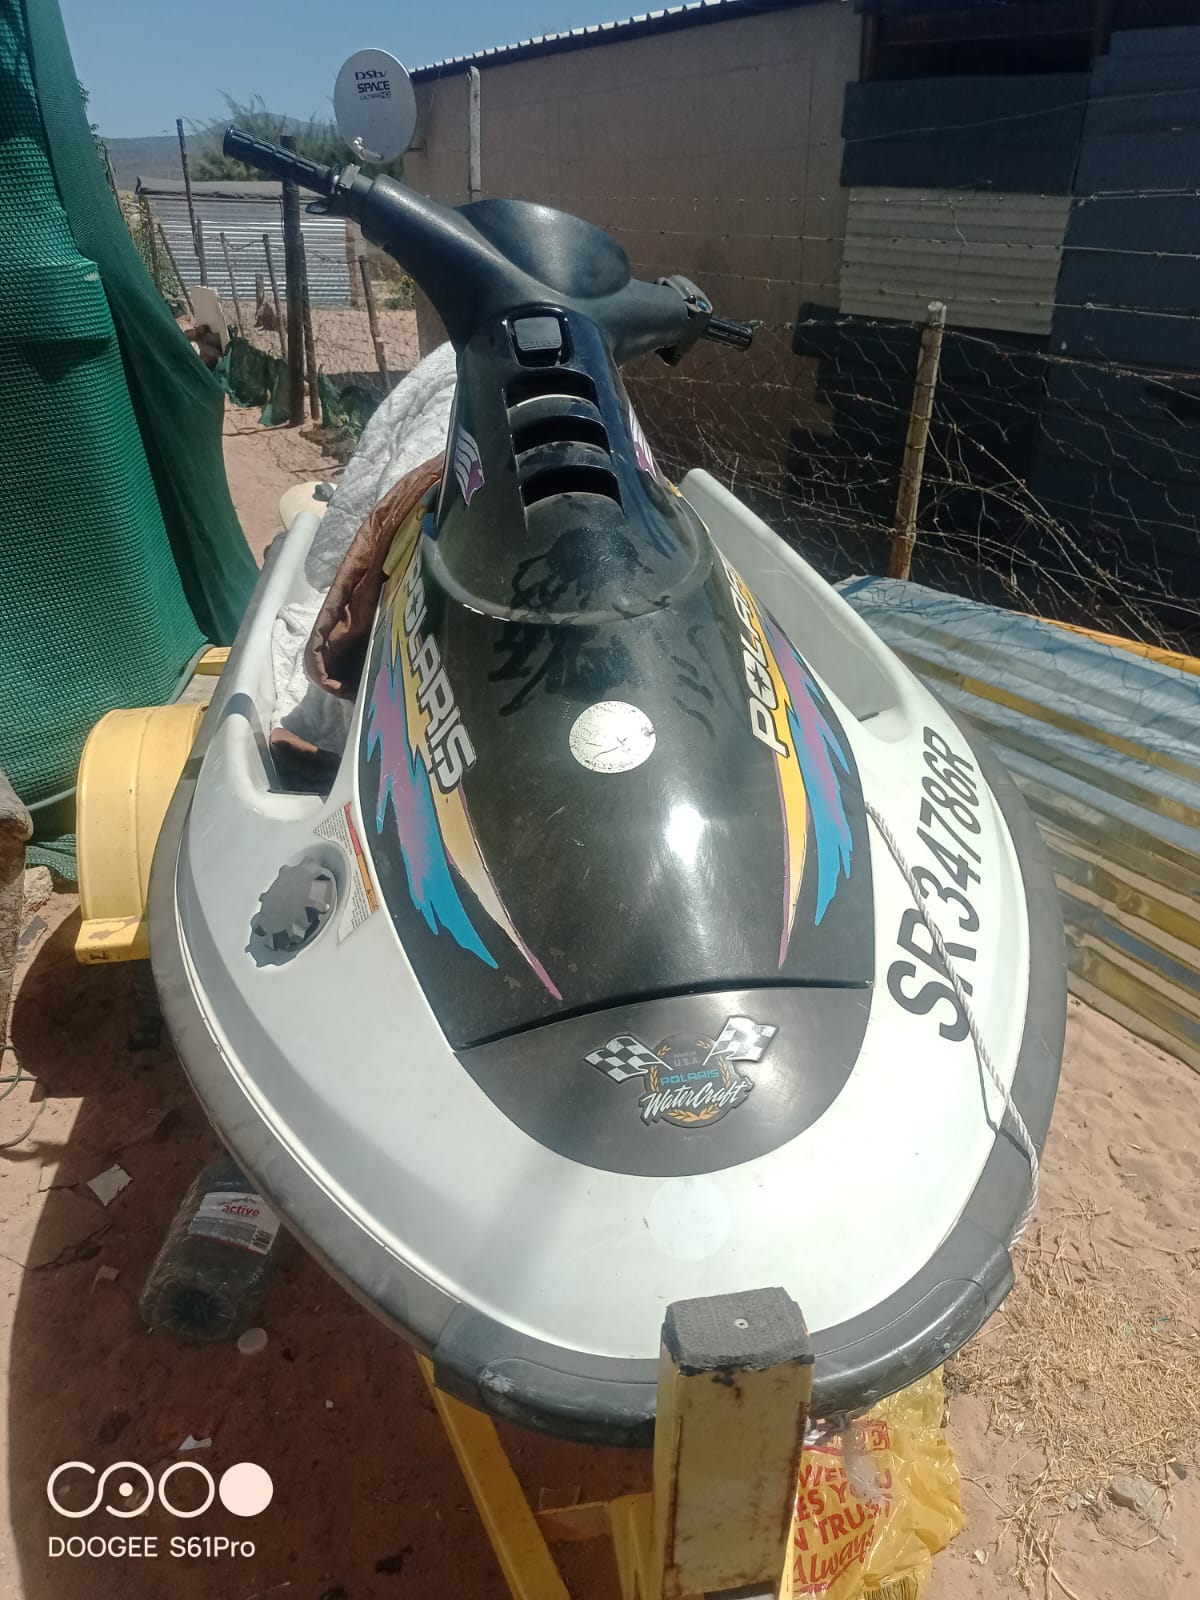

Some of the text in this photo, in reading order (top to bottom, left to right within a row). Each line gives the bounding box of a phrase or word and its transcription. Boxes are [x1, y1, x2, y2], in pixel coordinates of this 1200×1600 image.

[357, 80, 390, 93] SPACE
[403, 546, 477, 793] POLARIS
[660, 1068, 720, 1086] POLARIS
[222, 1204, 260, 1217] active
